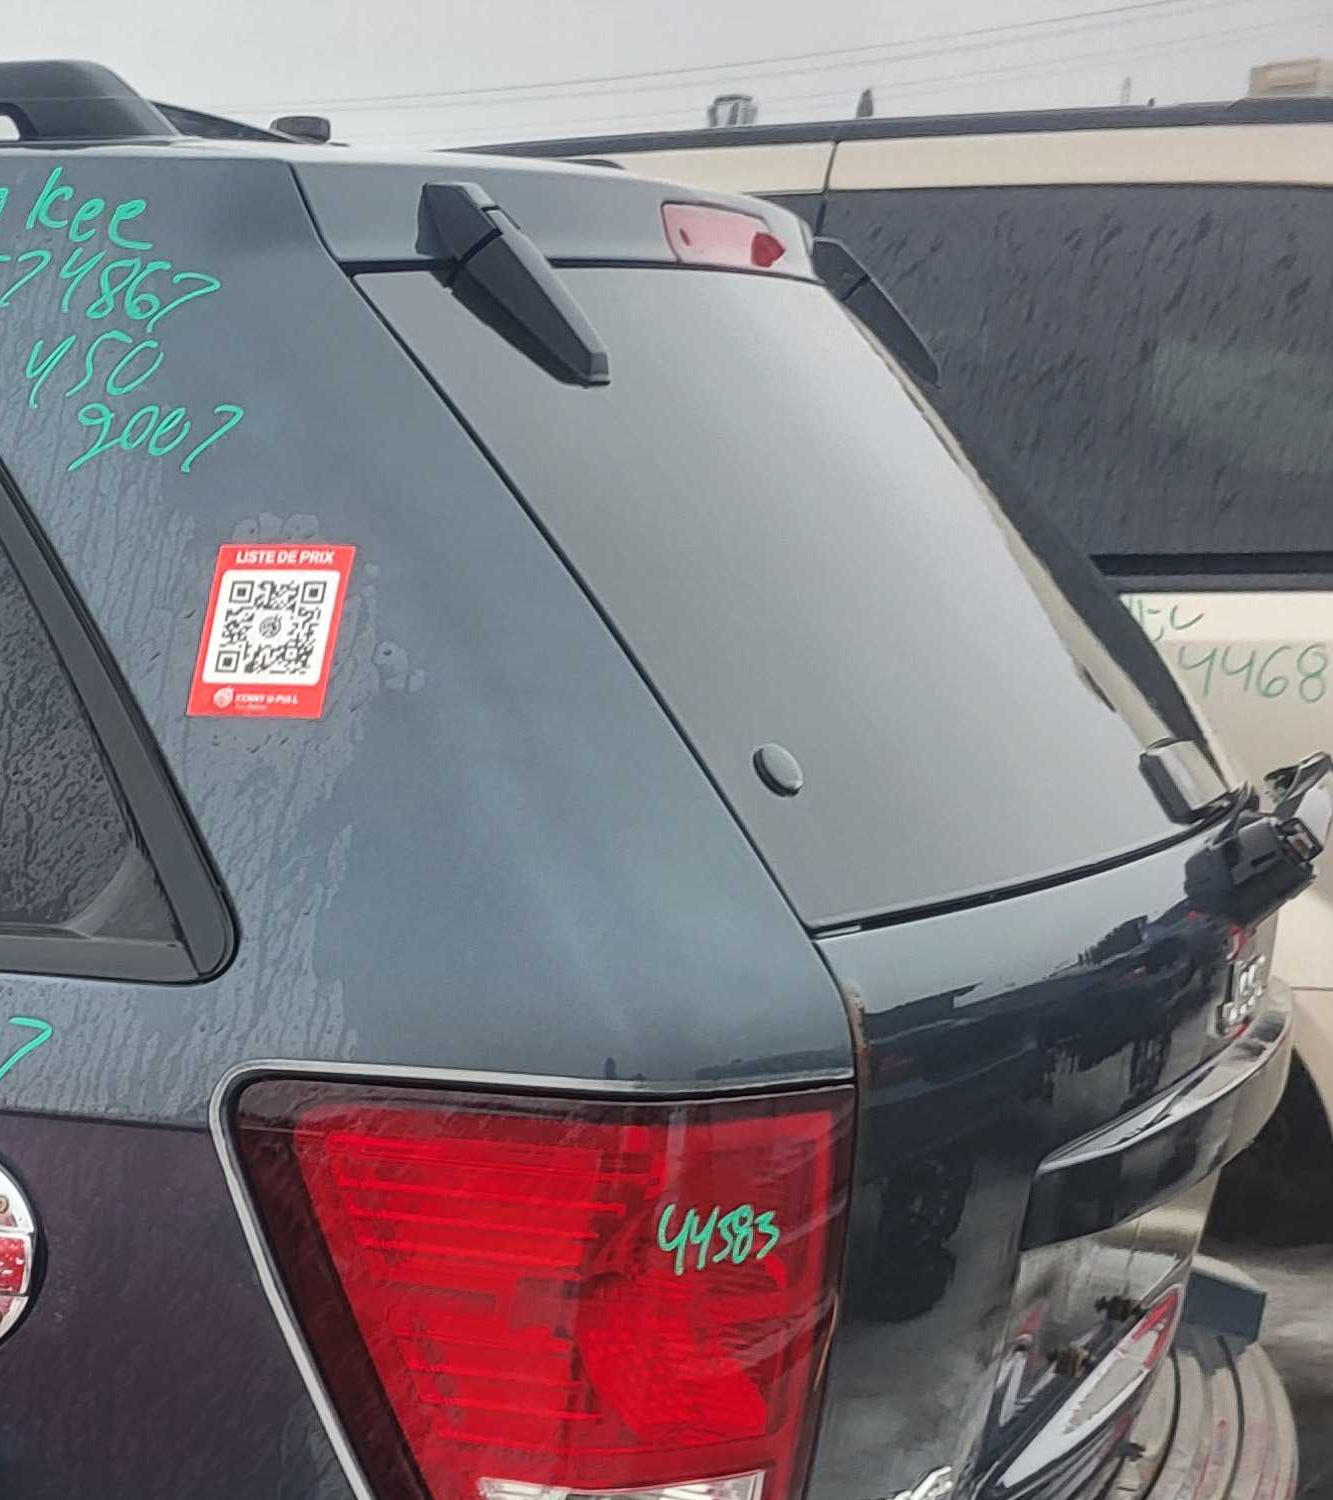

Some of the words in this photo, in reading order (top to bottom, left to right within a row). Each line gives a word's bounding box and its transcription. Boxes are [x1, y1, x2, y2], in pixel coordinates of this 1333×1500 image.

[24, 328, 166, 410] 450
[67, 403, 245, 473] 2007
[235, 550, 276, 565] LISTE
[276, 550, 299, 565] DE
[298, 550, 336, 565] PRIX
